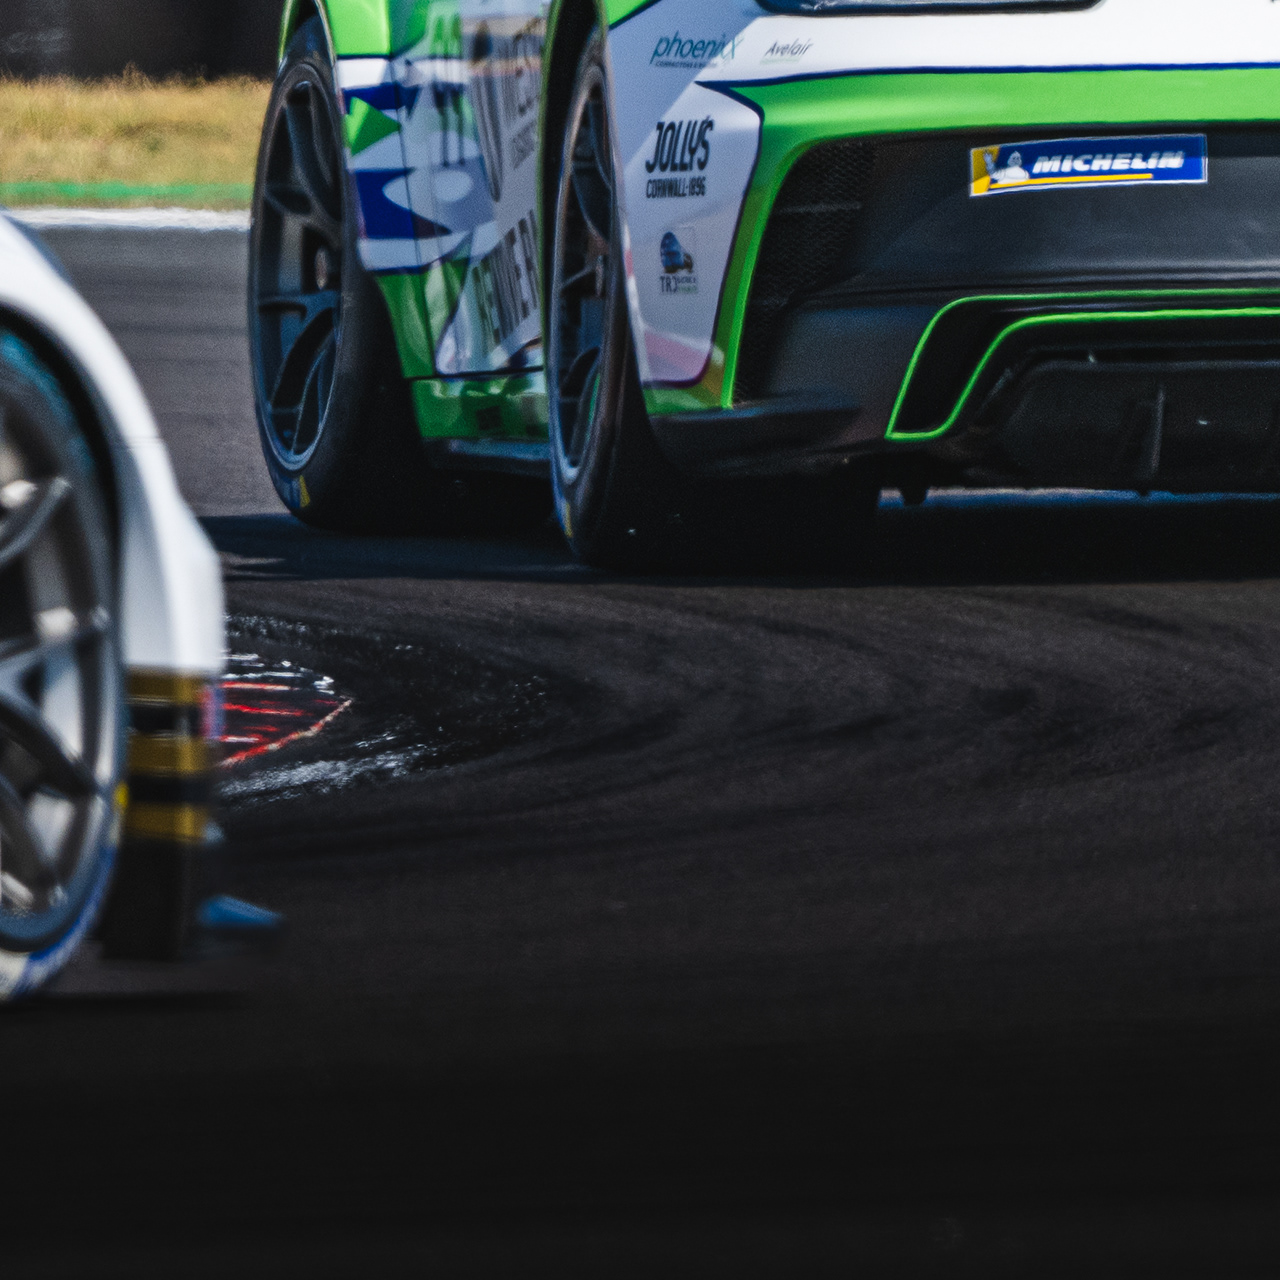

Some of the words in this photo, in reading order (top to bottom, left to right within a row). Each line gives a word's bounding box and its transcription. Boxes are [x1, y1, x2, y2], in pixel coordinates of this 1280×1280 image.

[764, 37, 814, 57] Avelair
[645, 115, 715, 173] JOLLY'S
[1031, 150, 1185, 174] MICHELIN
